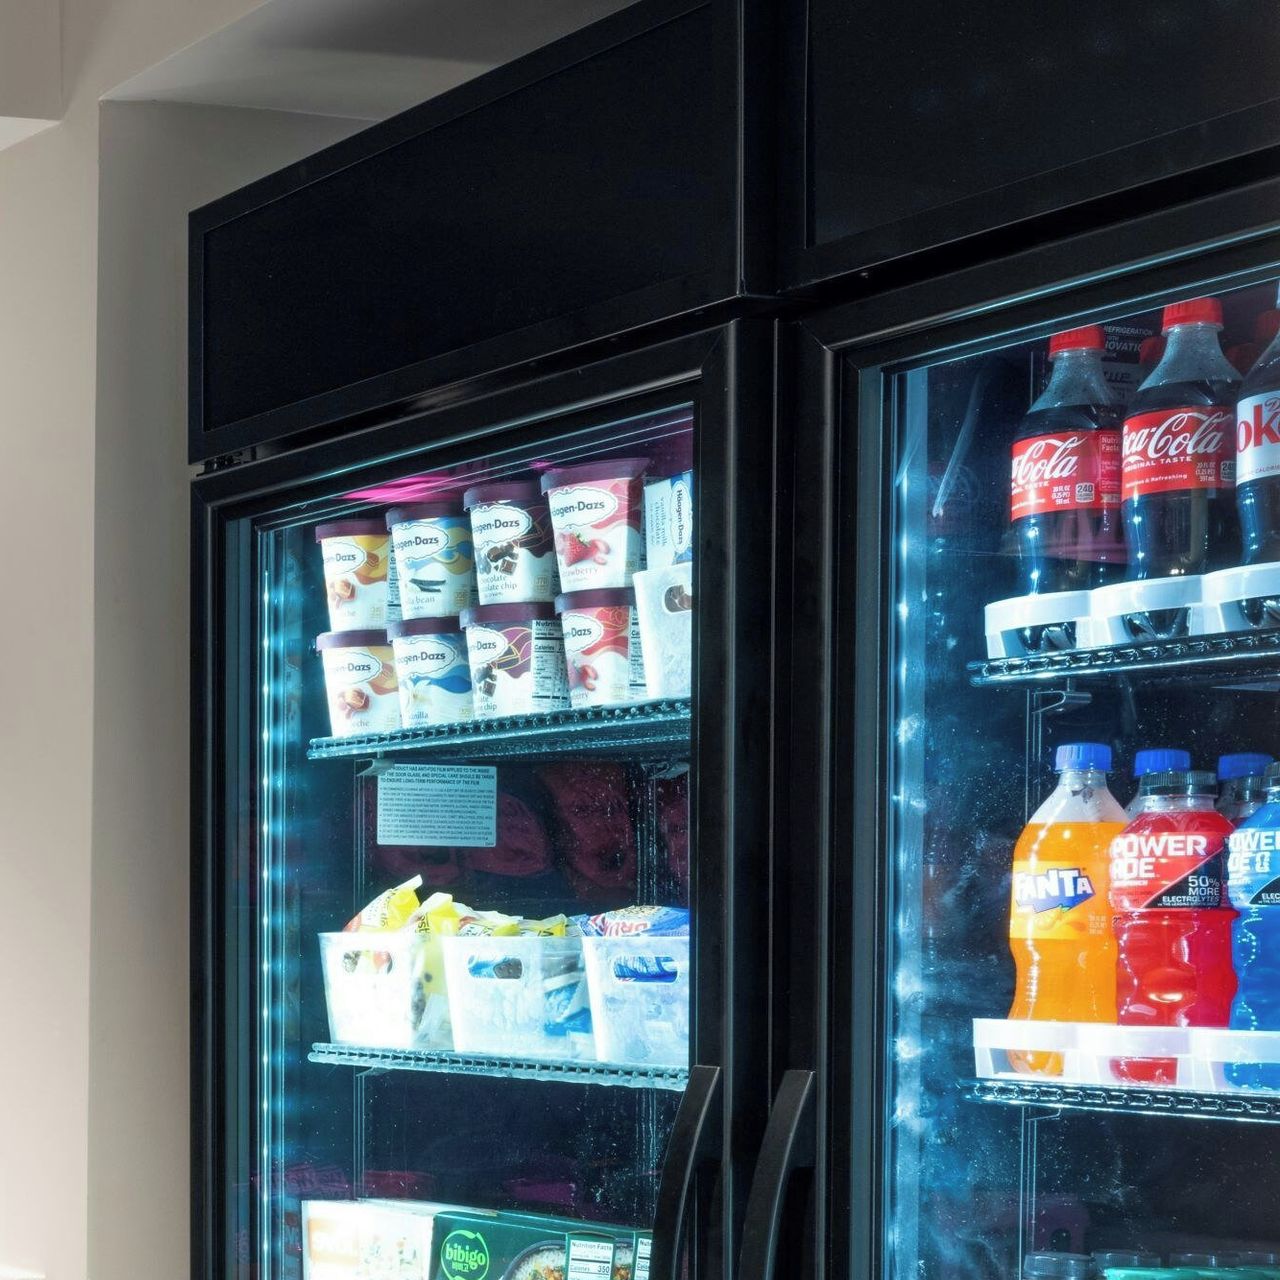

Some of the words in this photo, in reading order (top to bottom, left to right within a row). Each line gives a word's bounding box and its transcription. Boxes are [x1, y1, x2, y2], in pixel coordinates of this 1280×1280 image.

[1160, 456, 1192, 464] TASTE
[1111, 834, 1207, 858] POWER
[1189, 888, 1220, 896] MORE
[445, 1243, 486, 1270] bibigo
